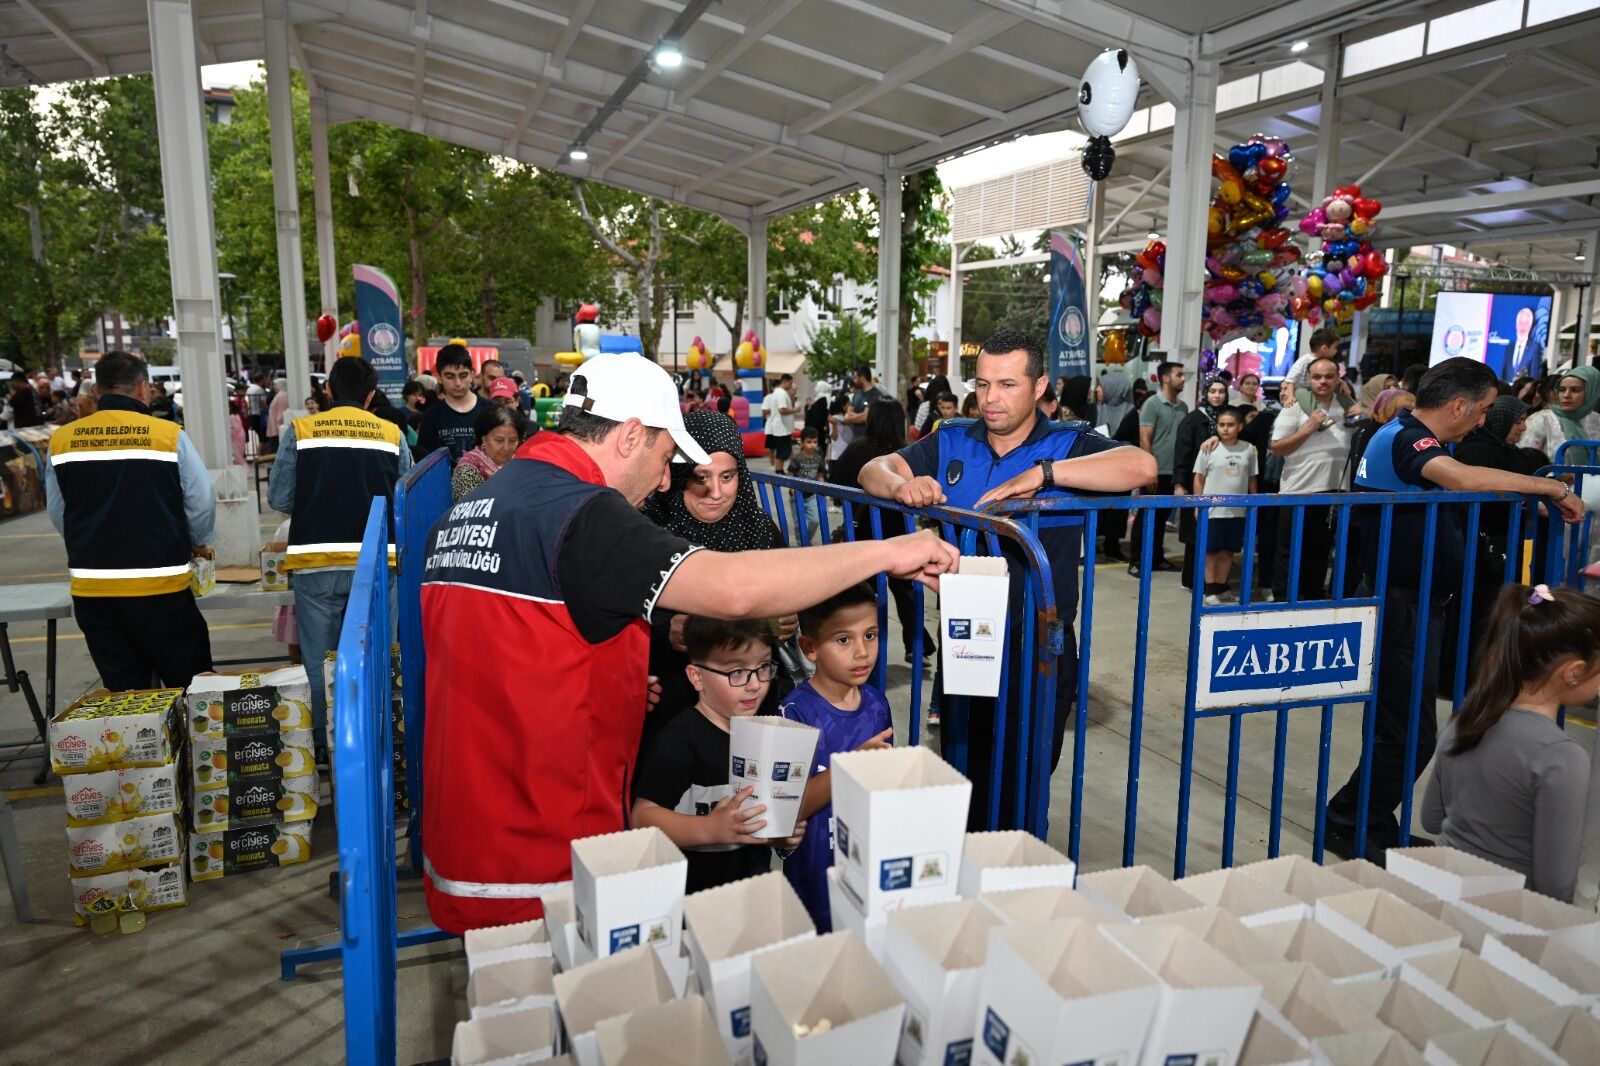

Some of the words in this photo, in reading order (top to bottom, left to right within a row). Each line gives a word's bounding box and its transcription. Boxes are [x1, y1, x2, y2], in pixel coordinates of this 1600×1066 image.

[314, 418, 342, 428] ISPARTA
[73, 426, 104, 436] ISPARTA
[448, 498, 495, 522] ISPARTA
[435, 520, 499, 550] BELEDİYESİ
[1214, 637, 1356, 678] ZABITA
[231, 698, 271, 712] erciyes
[236, 715, 267, 725] limonata
[57, 739, 87, 749] erciyes
[234, 746, 274, 760] erciyes
[71, 791, 103, 802] erciyes
[236, 792, 275, 805] erciyes
[230, 835, 270, 850] erciyes
